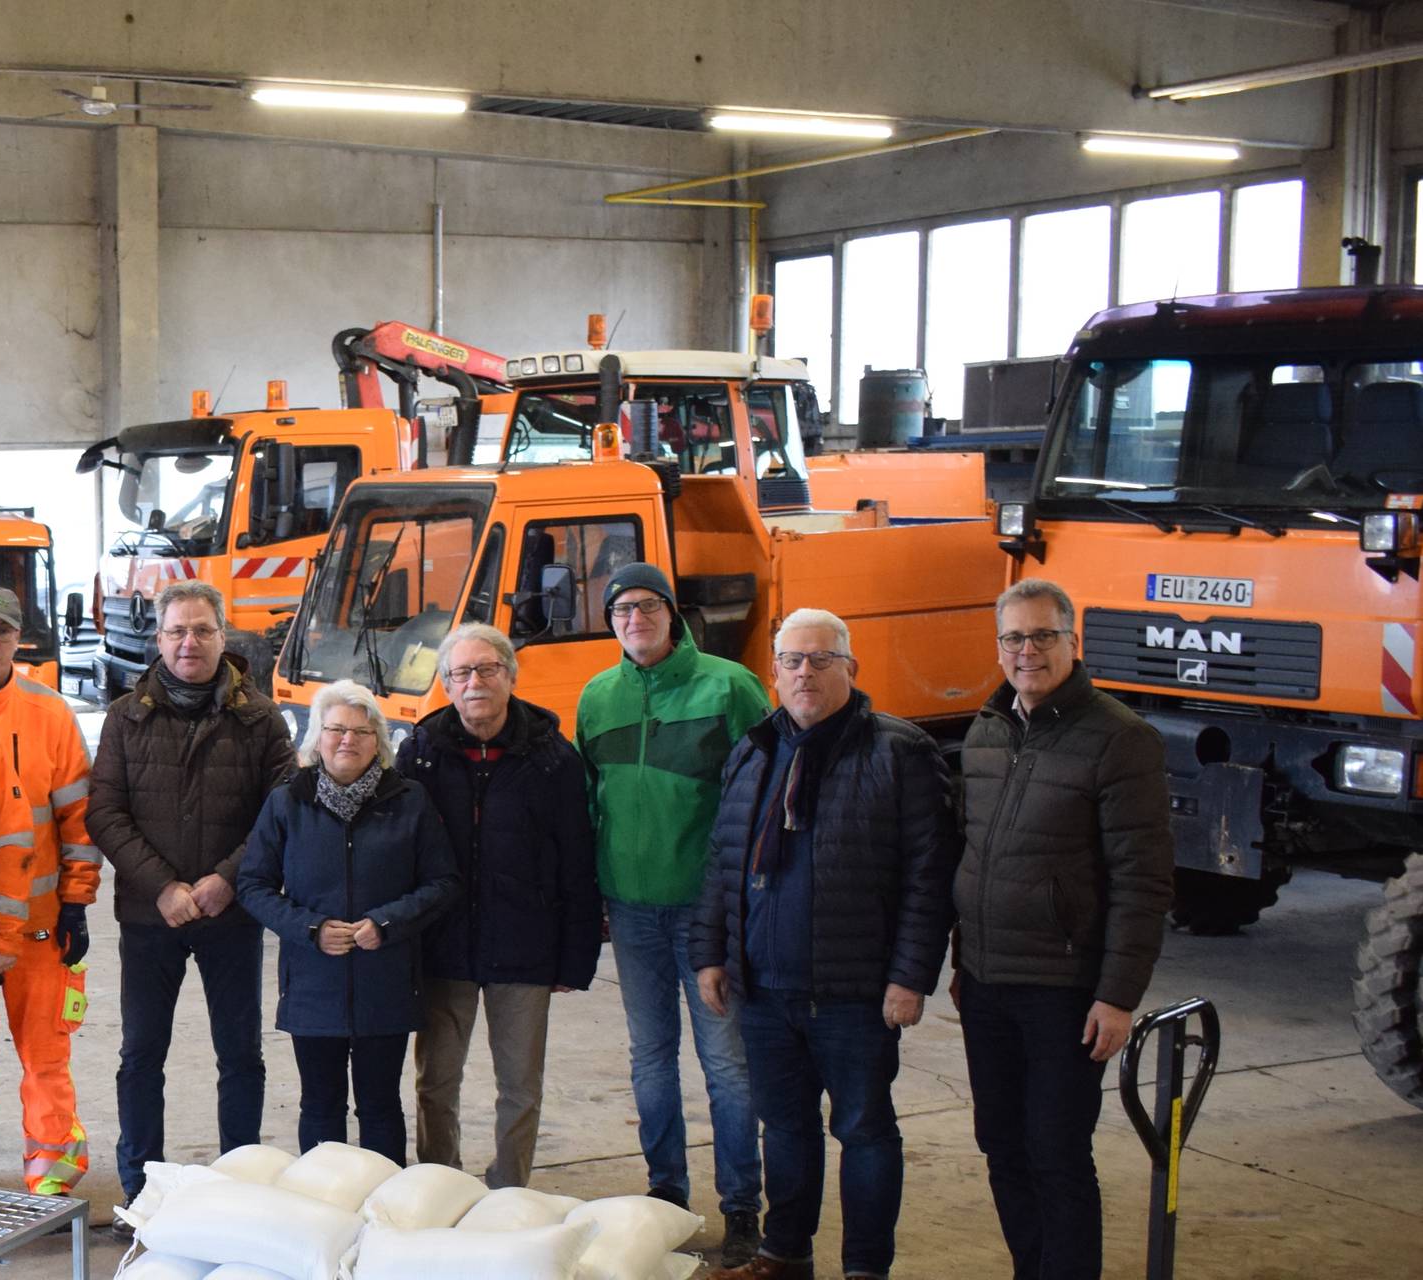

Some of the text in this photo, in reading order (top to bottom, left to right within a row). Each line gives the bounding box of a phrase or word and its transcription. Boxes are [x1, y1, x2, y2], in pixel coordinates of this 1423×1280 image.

[405, 331, 466, 361] PALFINGER
[1160, 578, 1246, 603] EU 2460
[1145, 625, 1242, 655] MAN
